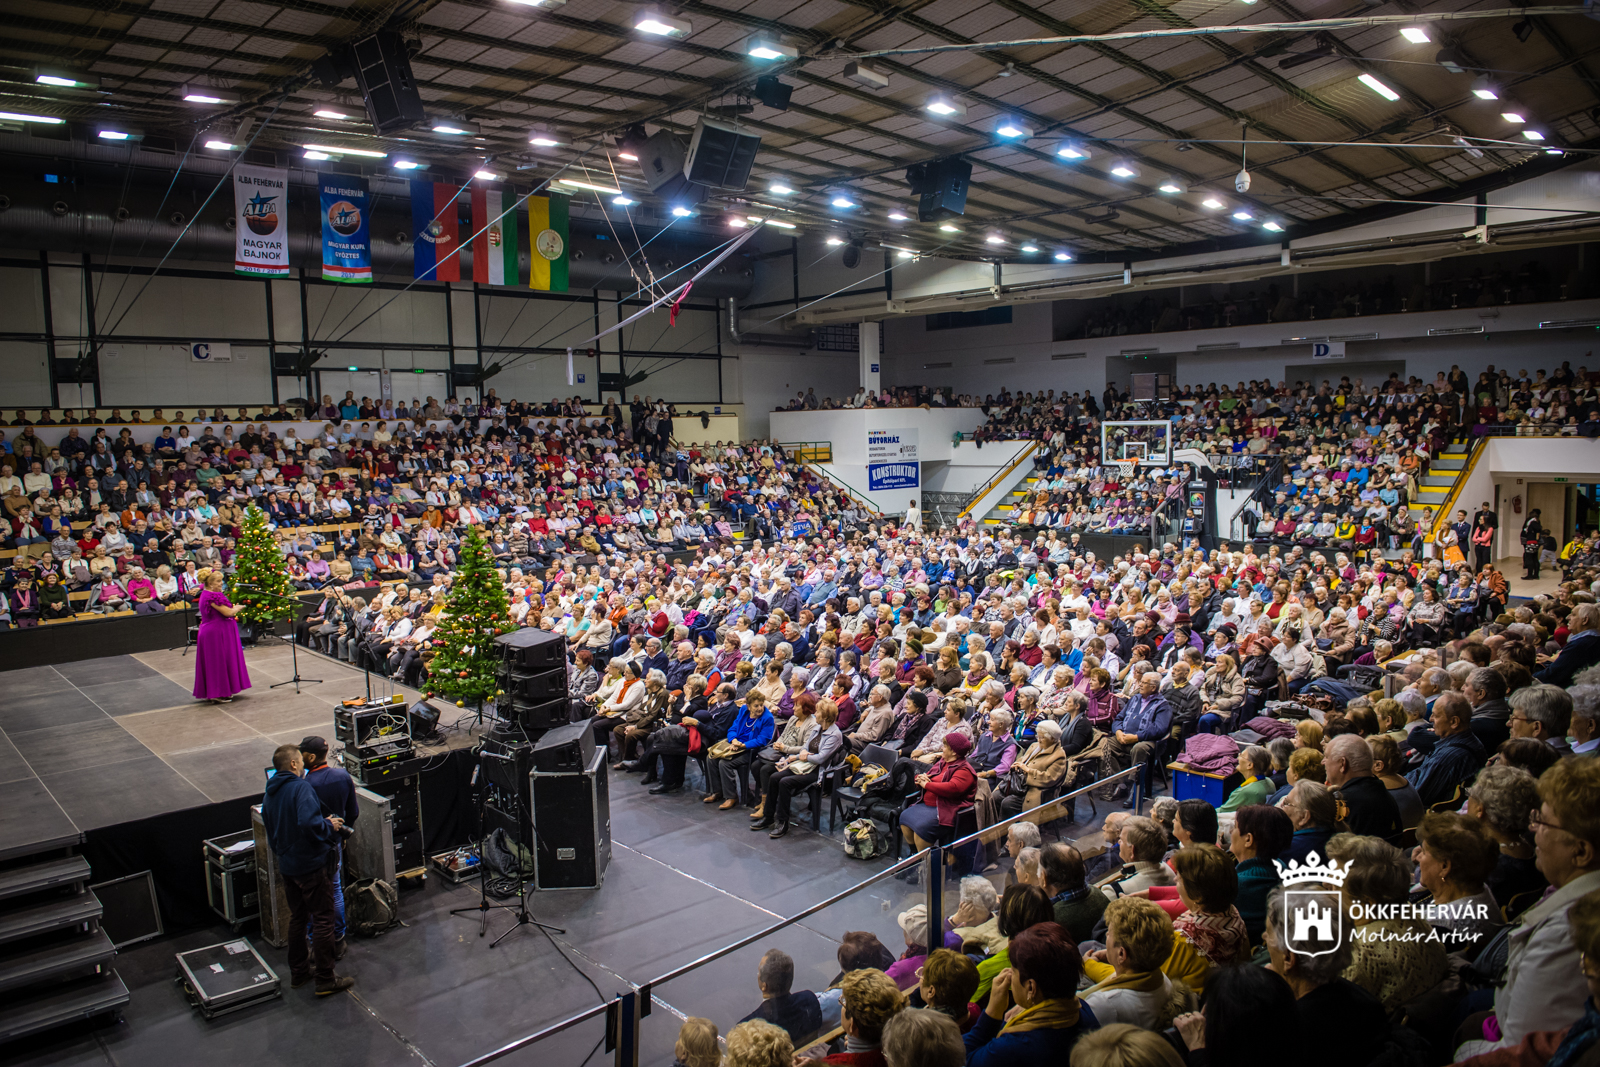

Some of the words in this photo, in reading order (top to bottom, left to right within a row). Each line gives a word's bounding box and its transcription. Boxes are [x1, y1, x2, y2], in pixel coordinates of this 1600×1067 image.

[238, 175, 252, 185] ALBA
[253, 178, 284, 189] FEHÉRVÁR
[324, 186, 337, 195] ALBA
[338, 188, 365, 198] FEHÉRVÁR
[242, 202, 277, 217] ALBA
[331, 215, 357, 226] ALBA
[243, 239, 282, 250] MAGYAR
[328, 241, 349, 250] MAGYAR
[243, 250, 281, 260] BAJNOK
[193, 344, 209, 359] C
[1314, 343, 1329, 357] D
[869, 435, 900, 444] BÚTORHÁZ
[872, 464, 916, 481] KONSTRUKTOR
